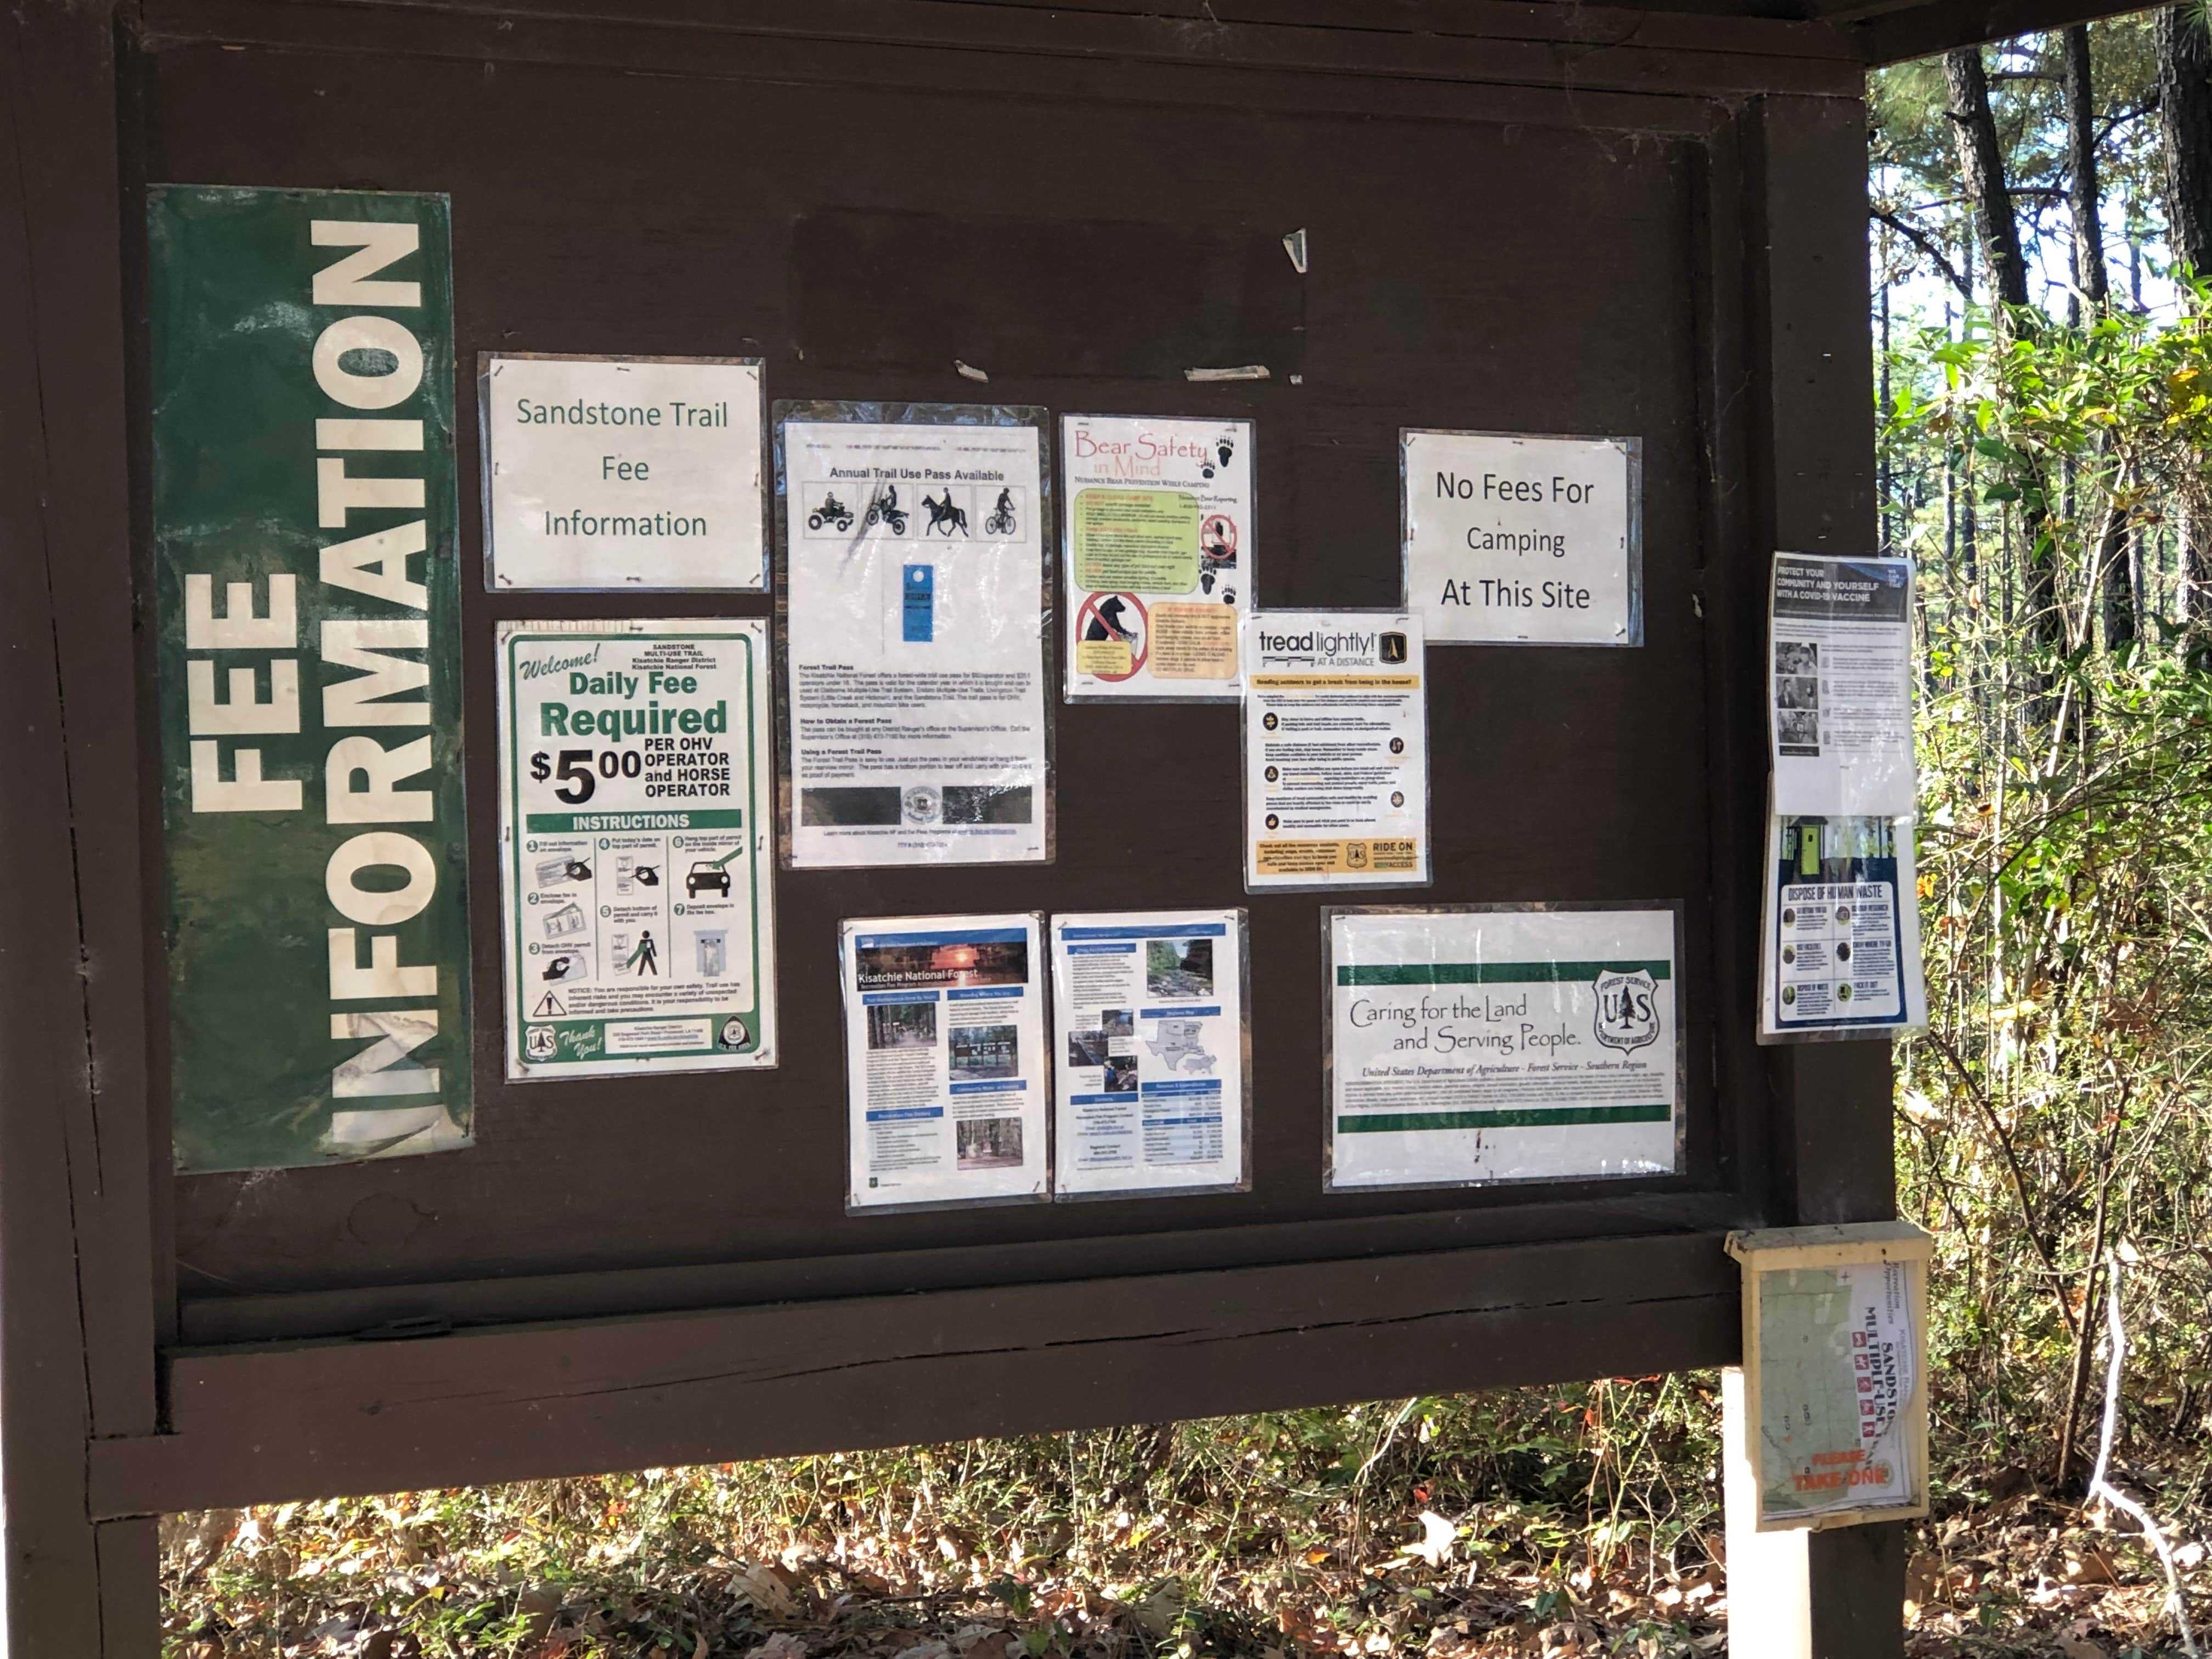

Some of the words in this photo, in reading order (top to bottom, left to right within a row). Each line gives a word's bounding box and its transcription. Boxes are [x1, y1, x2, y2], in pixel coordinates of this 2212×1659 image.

[517, 399, 661, 425] Sandstone
[670, 402, 728, 427] Trail
[1075, 430, 1131, 458] Bear
[1135, 433, 1208, 467] Safety
[603, 456, 649, 481] Fee
[830, 467, 870, 478] Annual
[873, 467, 897, 479] Trail
[900, 469, 921, 479] Use
[925, 469, 951, 480] Pass
[954, 470, 1004, 481] Available
[1094, 462, 1108, 474] in
[1114, 455, 1161, 477] Mind
[1436, 471, 1473, 499] No
[1483, 473, 1543, 502] Fees
[1553, 476, 1595, 504] For
[545, 510, 707, 536] Information
[1467, 527, 1565, 557] Camping
[1778, 566, 1804, 575] PROTECT
[1806, 568, 1825, 578] YOUR
[1441, 579, 1471, 606] At
[1479, 579, 1533, 607] This
[1542, 580, 1590, 608] Site
[1777, 578, 1815, 588] COMMUNITY
[1816, 580, 1832, 590] AND
[1833, 582, 1879, 591] YOURSELF
[1776, 590, 1792, 599] WITH
[1793, 590, 1799, 599] A
[1800, 591, 1830, 601] COVID-19
[1833, 592, 1870, 602] VACCINE
[520, 643, 600, 680] Welcome!
[185, 573, 302, 812] FEE
[311, 219, 445, 1144] INFORMATION
[569, 672, 639, 699] Daily
[648, 672, 697, 693] Fee
[540, 700, 727, 742] Required
[645, 738, 674, 751] PER
[680, 737, 713, 750] OHV
[645, 753, 729, 766] OPERATOR
[645, 770, 673, 782] and
[678, 768, 730, 781] HORSE
[645, 784, 730, 798] OPERATOR
[573, 814, 690, 830] INSTRUCTIONS
[1373, 843, 1397, 851] RIDE
[1398, 842, 1413, 850] ON
[1788, 887, 1816, 901] DISPOSE
[1817, 886, 1825, 900] OF
[1827, 885, 1854, 899] HUMAN
[1856, 885, 1882, 898] WASTE
[859, 972, 903, 984] Kisatchie
[905, 969, 945, 981] National
[1600, 977, 1624, 992] FOREST
[1626, 976, 1651, 991] SERVICE
[1350, 998, 1417, 1028] Caring
[1420, 996, 1448, 1020] for
[1452, 995, 1481, 1020] the
[1485, 994, 1527, 1023] Land
[560, 1025, 595, 1046] Thank
[1393, 1026, 1427, 1051] and
[1434, 1025, 1514, 1055] Serving
[1520, 1023, 1582, 1056] People.
[574, 1037, 602, 1060] You!
[1362, 1066, 1391, 1077] United
[1392, 1066, 1414, 1076] States
[1417, 1065, 1465, 1078] Department
[1466, 1065, 1476, 1076] of
[1476, 1063, 1520, 1076] Agriculture
[1527, 1063, 1549, 1072] Forest
[1552, 1062, 1578, 1071] Service
[1586, 1060, 1620, 1070] Southern
[1622, 1059, 1647, 1071] Region
[1813, 1449, 1865, 1466] PLEASE
[1793, 1471, 1841, 1492] TAKE
[1847, 1466, 1889, 1486] ONE
